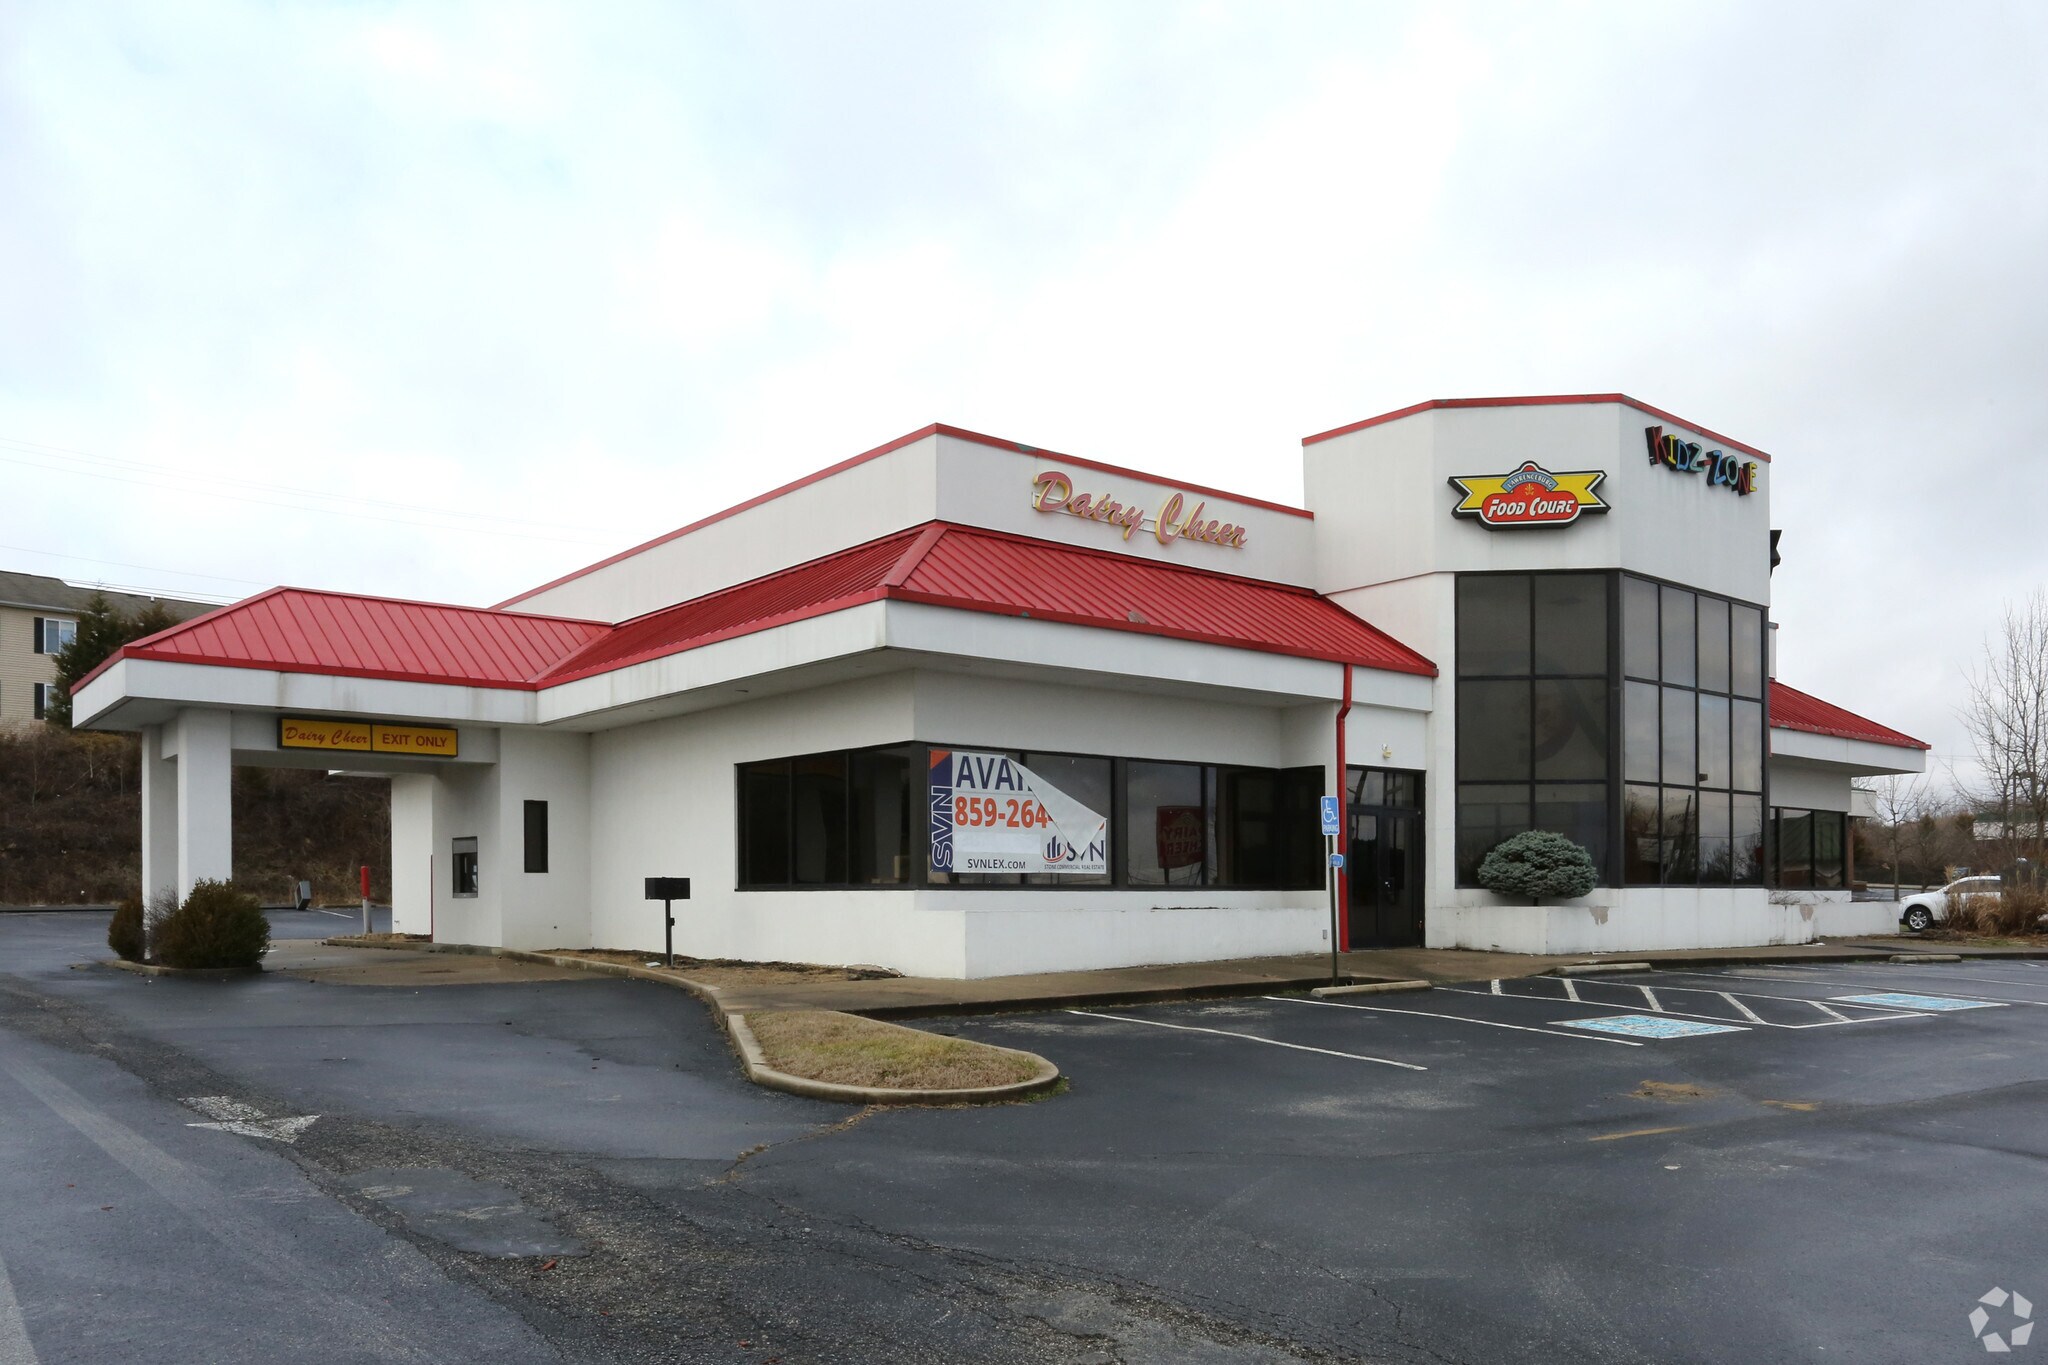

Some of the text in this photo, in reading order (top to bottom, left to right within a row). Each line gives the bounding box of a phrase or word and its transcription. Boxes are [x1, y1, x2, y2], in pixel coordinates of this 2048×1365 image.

[1645, 425, 1758, 497] KIDZ-ZONE
[1506, 474, 1553, 488] LAWRENCEBURG
[1033, 471, 1248, 549] Dairy Cheer
[1487, 496, 1575, 518] FOOD COURT
[285, 726, 368, 745] Dairy Cheer
[382, 733, 447, 748] EXIT ONLY
[956, 755, 1032, 791] AVAI
[931, 785, 953, 868] SVN
[967, 858, 1026, 869] SVNLEX.COM
